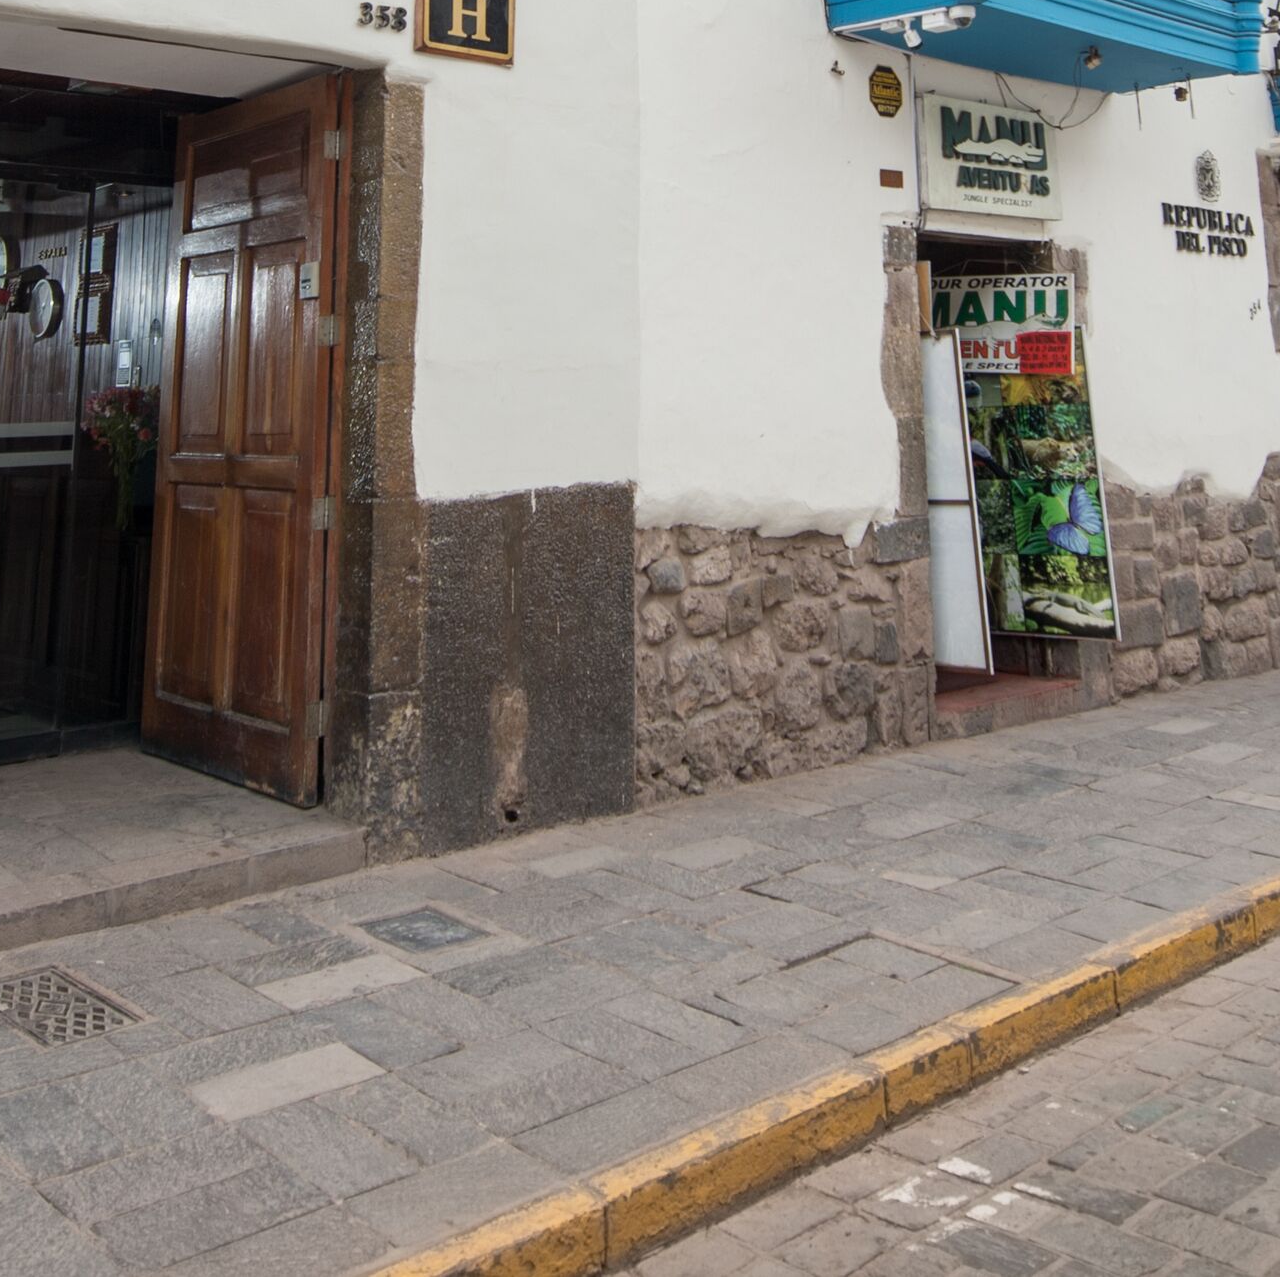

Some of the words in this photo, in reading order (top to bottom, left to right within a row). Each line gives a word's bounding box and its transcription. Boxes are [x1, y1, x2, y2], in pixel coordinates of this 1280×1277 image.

[357, 2, 407, 32] 358
[940, 106, 1048, 171] MANU
[963, 193, 989, 204] JUNGLE
[992, 197, 1032, 207] SPECIALIST
[1161, 202, 1255, 236] REPUBLICA
[1175, 230, 1205, 253] DEL
[1207, 234, 1248, 258] PISCO
[968, 276, 1068, 289] OPERATOR
